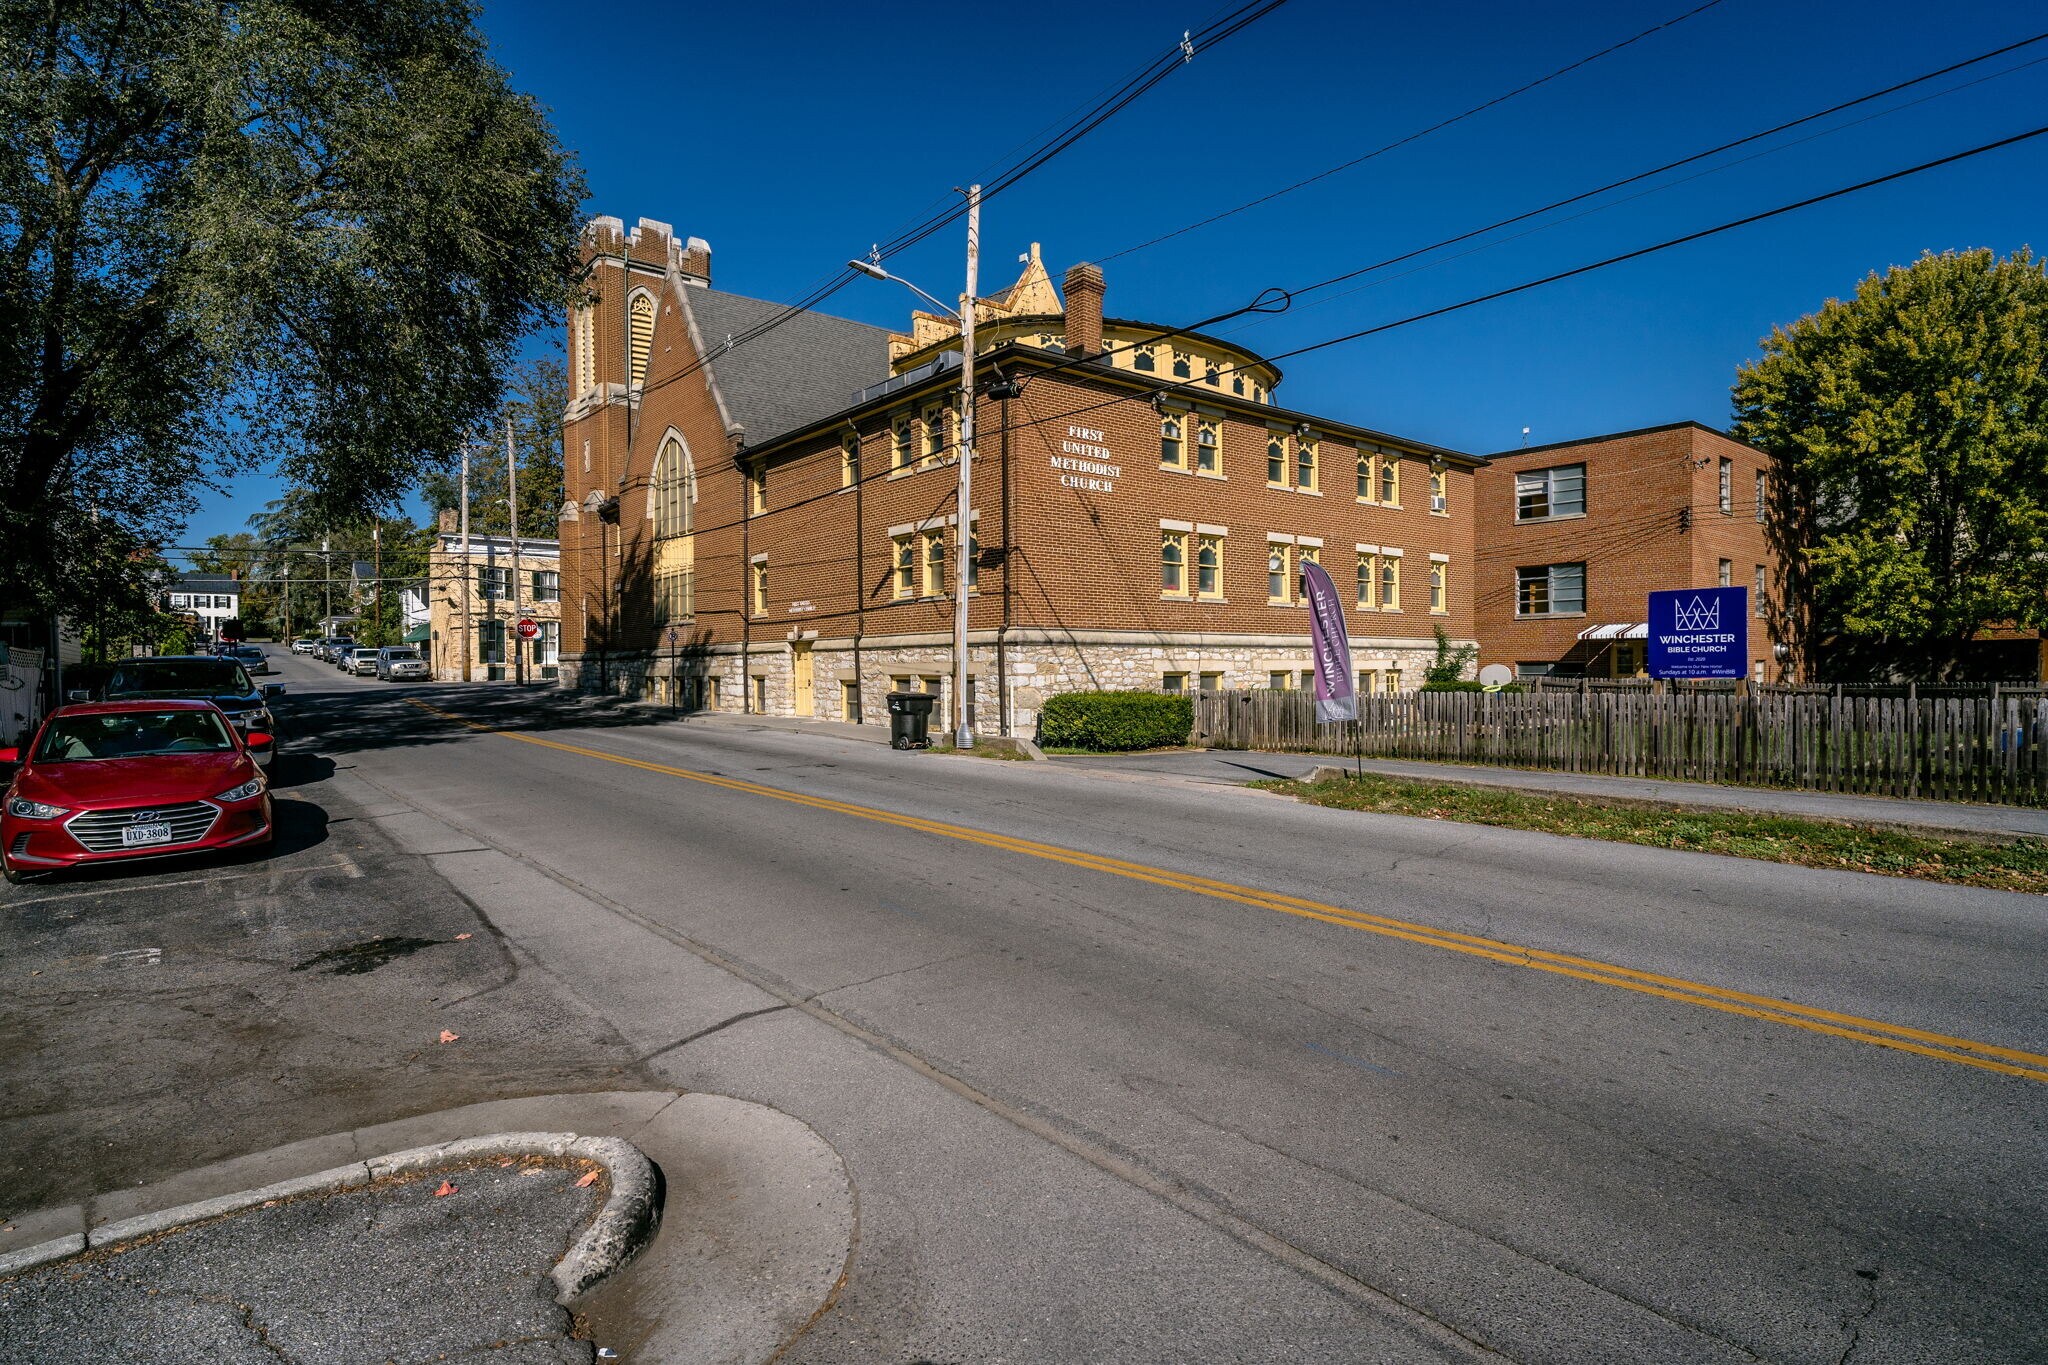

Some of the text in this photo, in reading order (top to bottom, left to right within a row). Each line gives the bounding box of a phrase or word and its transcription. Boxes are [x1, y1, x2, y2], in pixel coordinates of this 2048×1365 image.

[1069, 425, 1104, 442] FIRST
[1063, 440, 1109, 460] UNITED
[1051, 456, 1121, 477] METHODIST
[1061, 474, 1113, 492] CHURCH
[518, 624, 536, 632] STOP
[1316, 589, 1336, 697] WINCHESTER
[1660, 633, 1735, 644] WINCHESTER
[1691, 645, 1727, 653] CHURCH
[126, 827, 169, 841] UXD-3808
